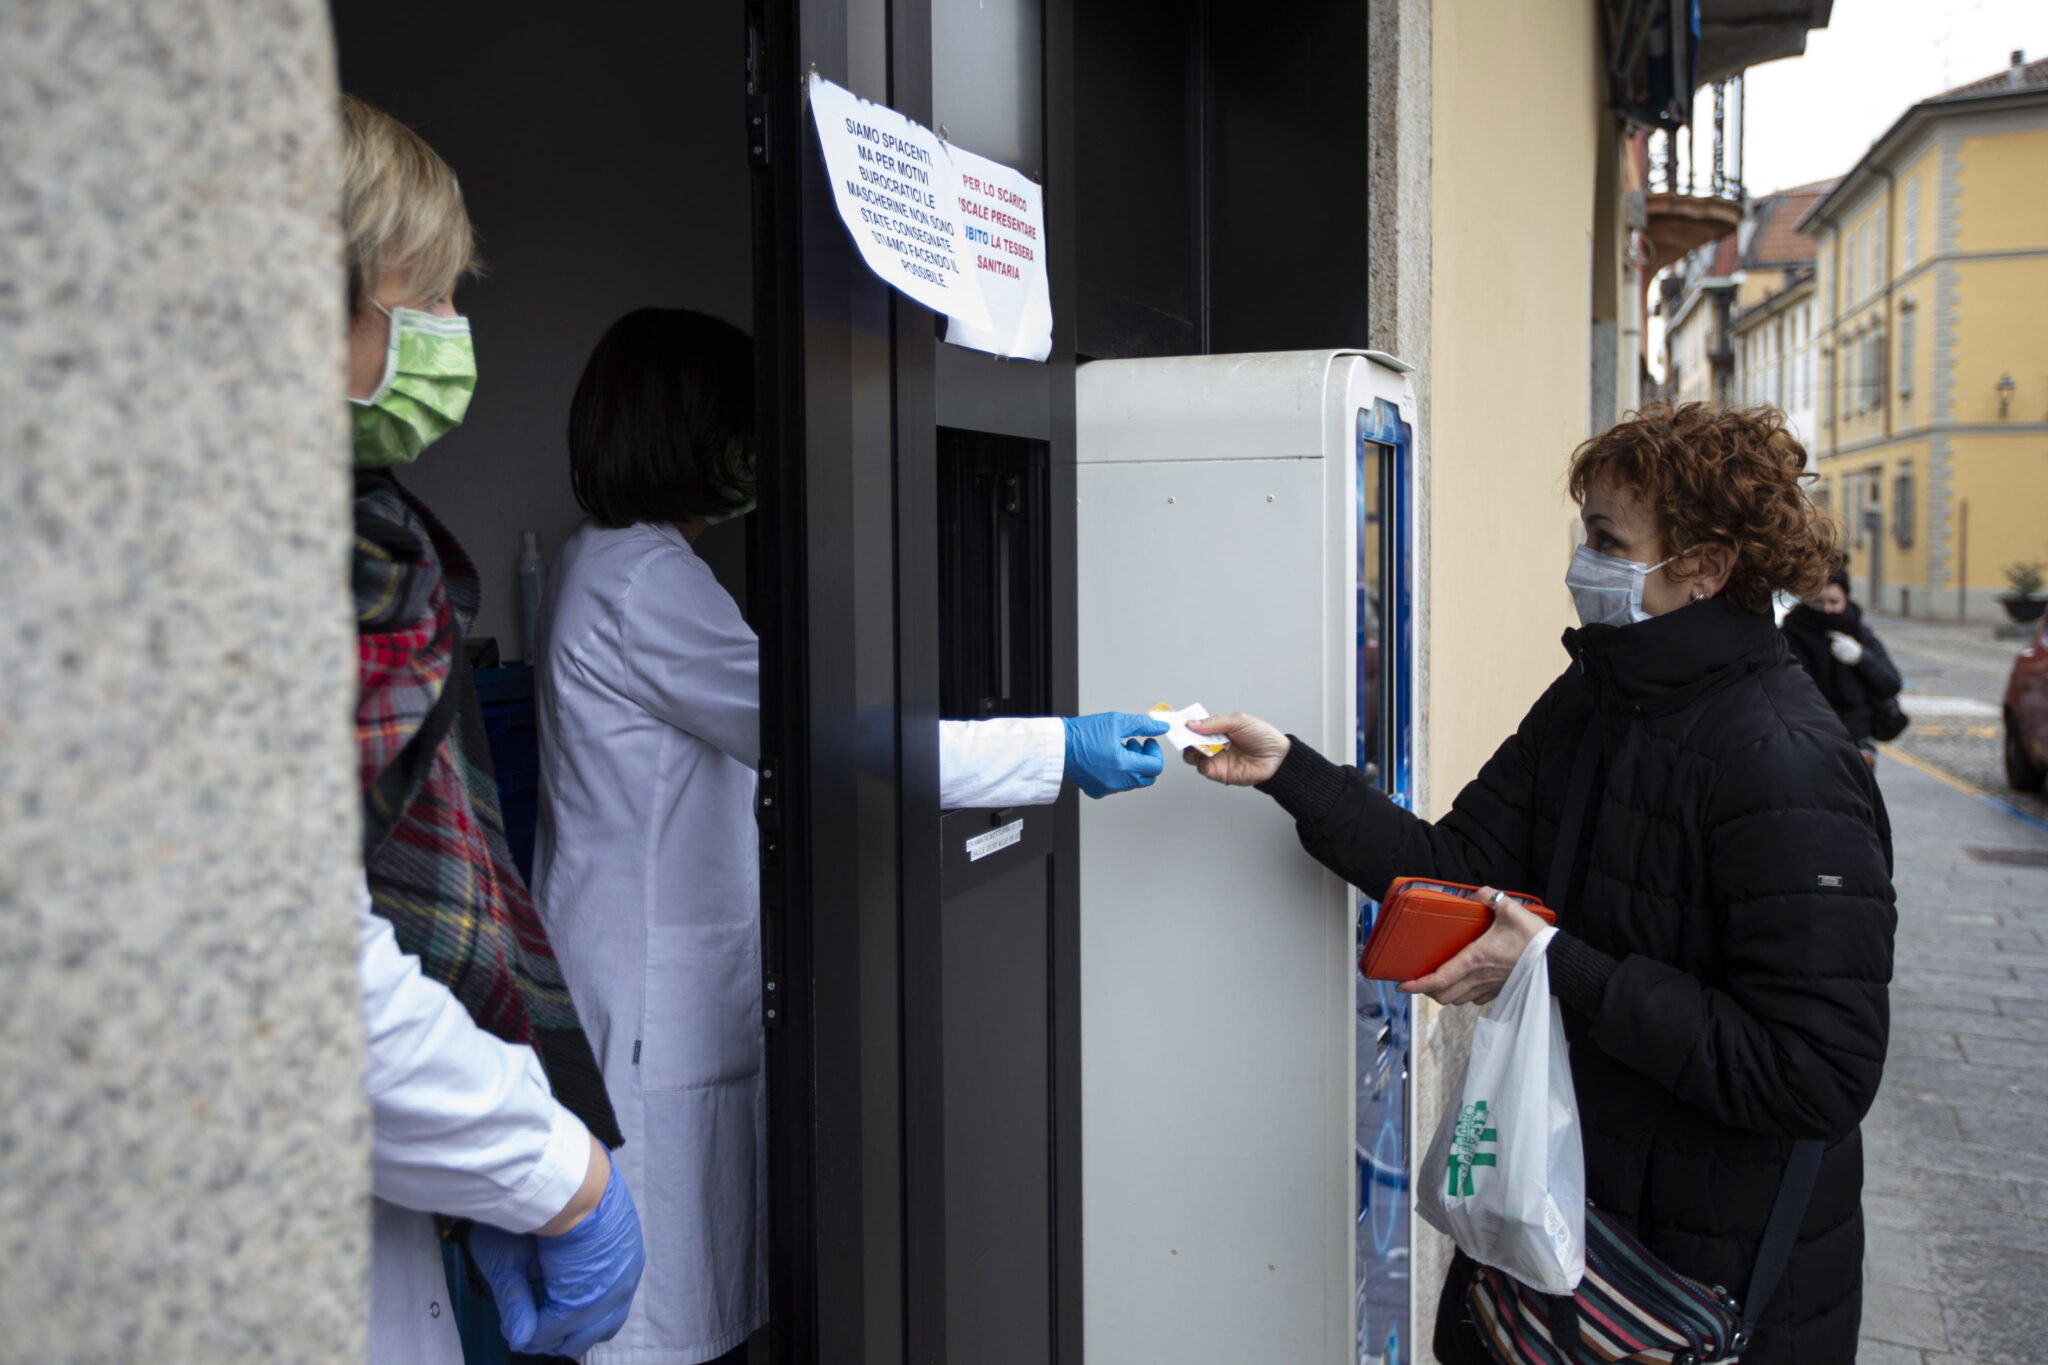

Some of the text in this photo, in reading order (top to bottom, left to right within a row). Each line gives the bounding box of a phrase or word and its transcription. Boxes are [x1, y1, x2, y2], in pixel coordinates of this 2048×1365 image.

[845, 117, 880, 144] SIAMO
[858, 144, 929, 186] MA PER MOTIVI
[859, 165, 936, 209] BUROCRATICI LE
[962, 174, 1027, 212] PER LO SCARICO
[846, 180, 954, 236] MASCHERINE NON SONO
[860, 207, 893, 231] STATE
[991, 209, 1037, 240] PRESENTARE
[872, 230, 960, 274] STIAMO FACENDO IL
[991, 234, 1002, 250] LA
[1003, 238, 1034, 262] TESSERA
[977, 255, 1020, 280] SANITARIA
